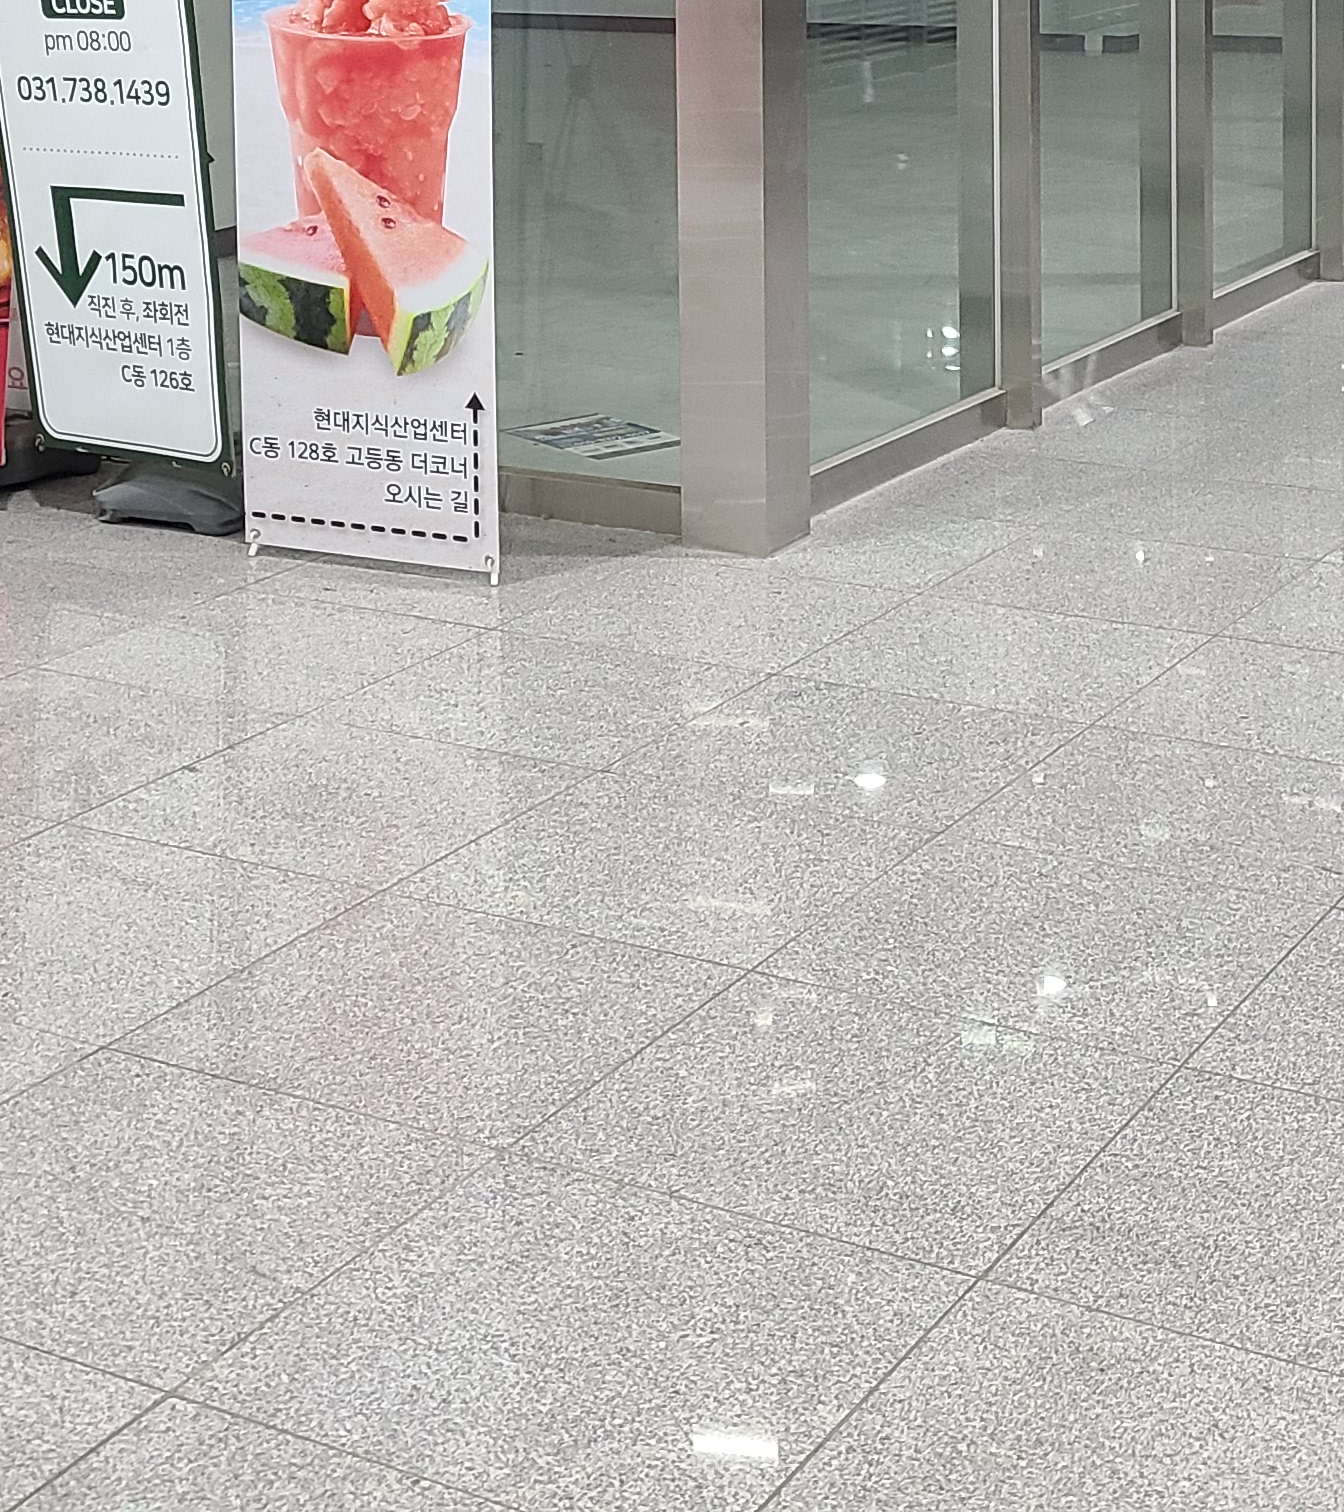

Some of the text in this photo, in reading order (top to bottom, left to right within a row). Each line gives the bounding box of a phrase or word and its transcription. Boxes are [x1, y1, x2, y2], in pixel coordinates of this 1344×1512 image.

[44, 31, 131, 56] pm 08:00
[17, 76, 170, 107] 031.738.1439
[104, 251, 187, 291] 150m
[87, 294, 190, 327] 직진 후, 좌회전
[44, 321, 193, 361] 현대지식산업센터 1층
[121, 364, 195, 393] C동 126호
[313, 407, 468, 445] 현대지식산업센터
[249, 436, 468, 480] C동 128호 고등동 더코너
[384, 483, 468, 514] 오시는 길
